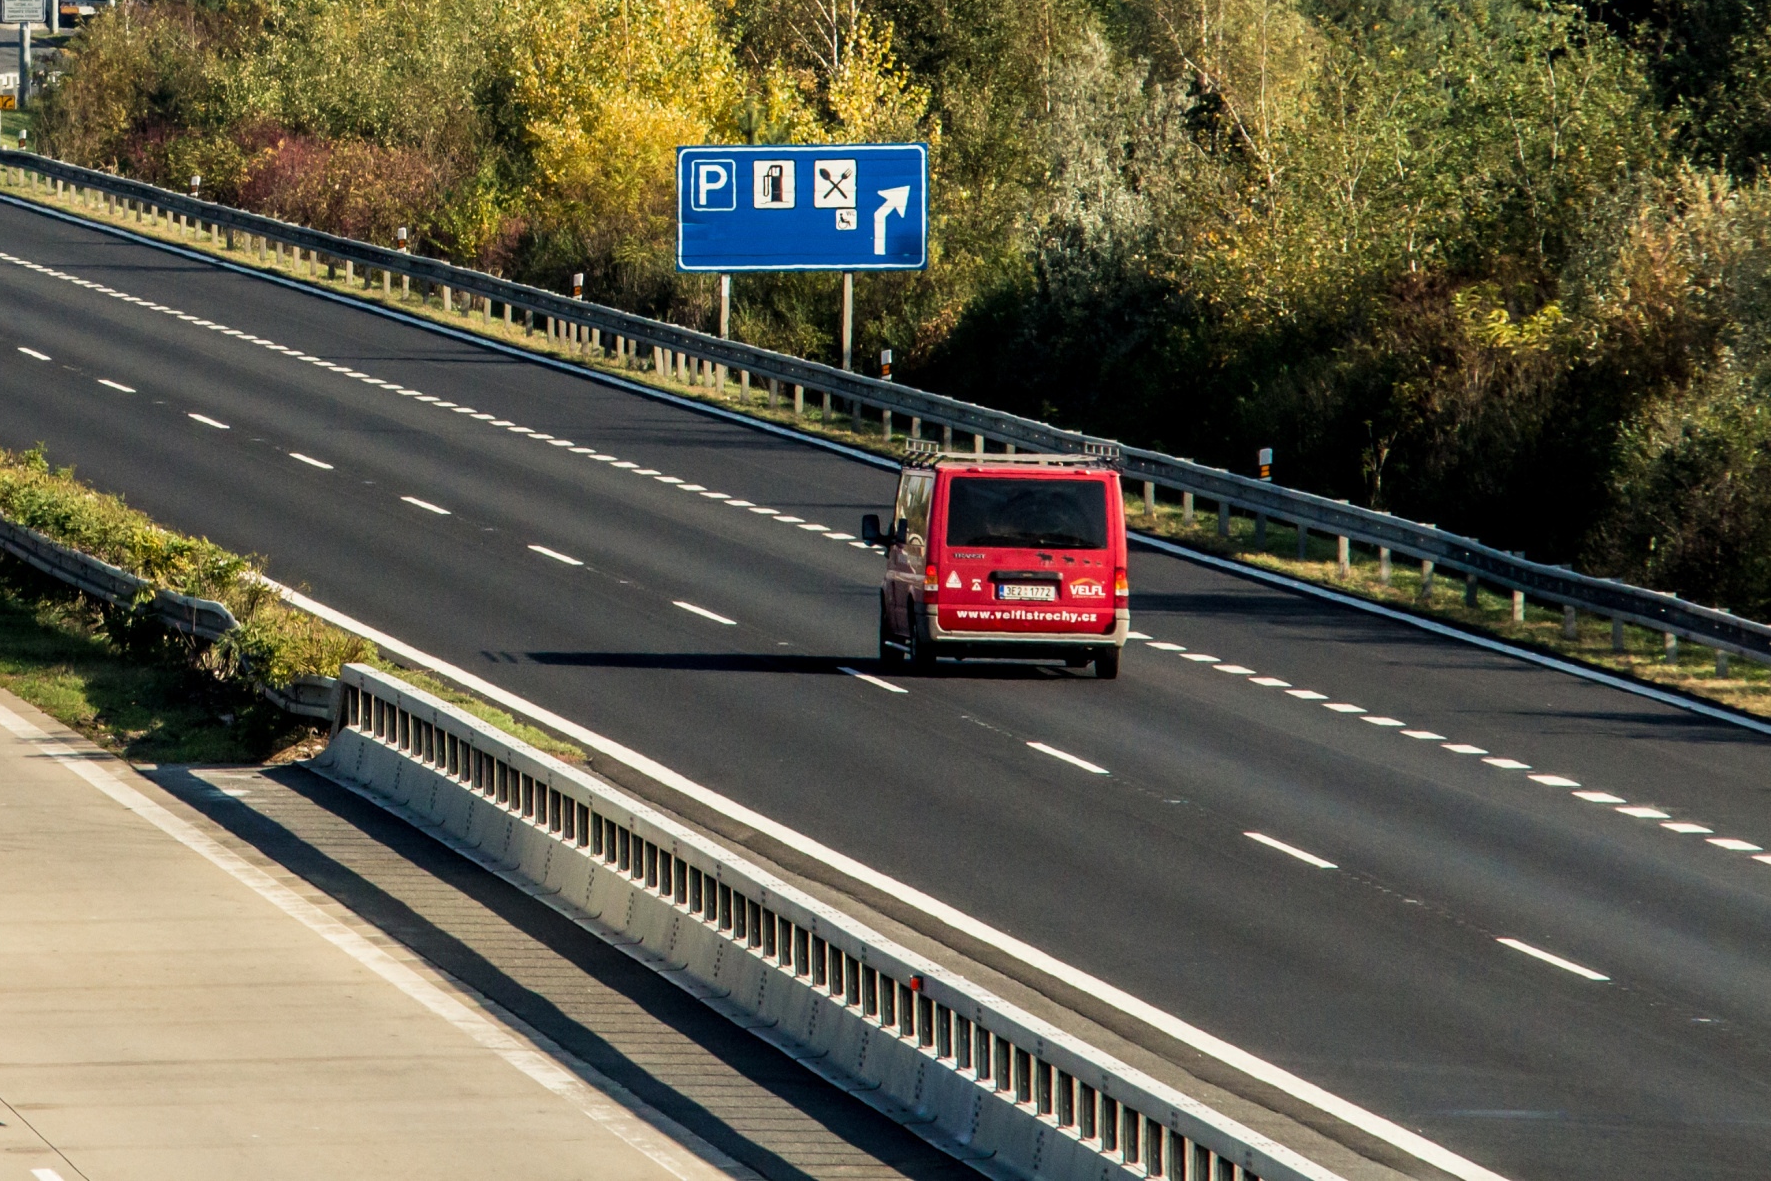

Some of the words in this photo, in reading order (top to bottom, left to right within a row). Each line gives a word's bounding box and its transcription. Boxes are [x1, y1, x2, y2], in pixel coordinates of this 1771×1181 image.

[699, 165, 727, 205] P
[1006, 586, 1022, 596] 3E2
[1030, 587, 1051, 597] 1772
[1070, 585, 1106, 596] VELFL
